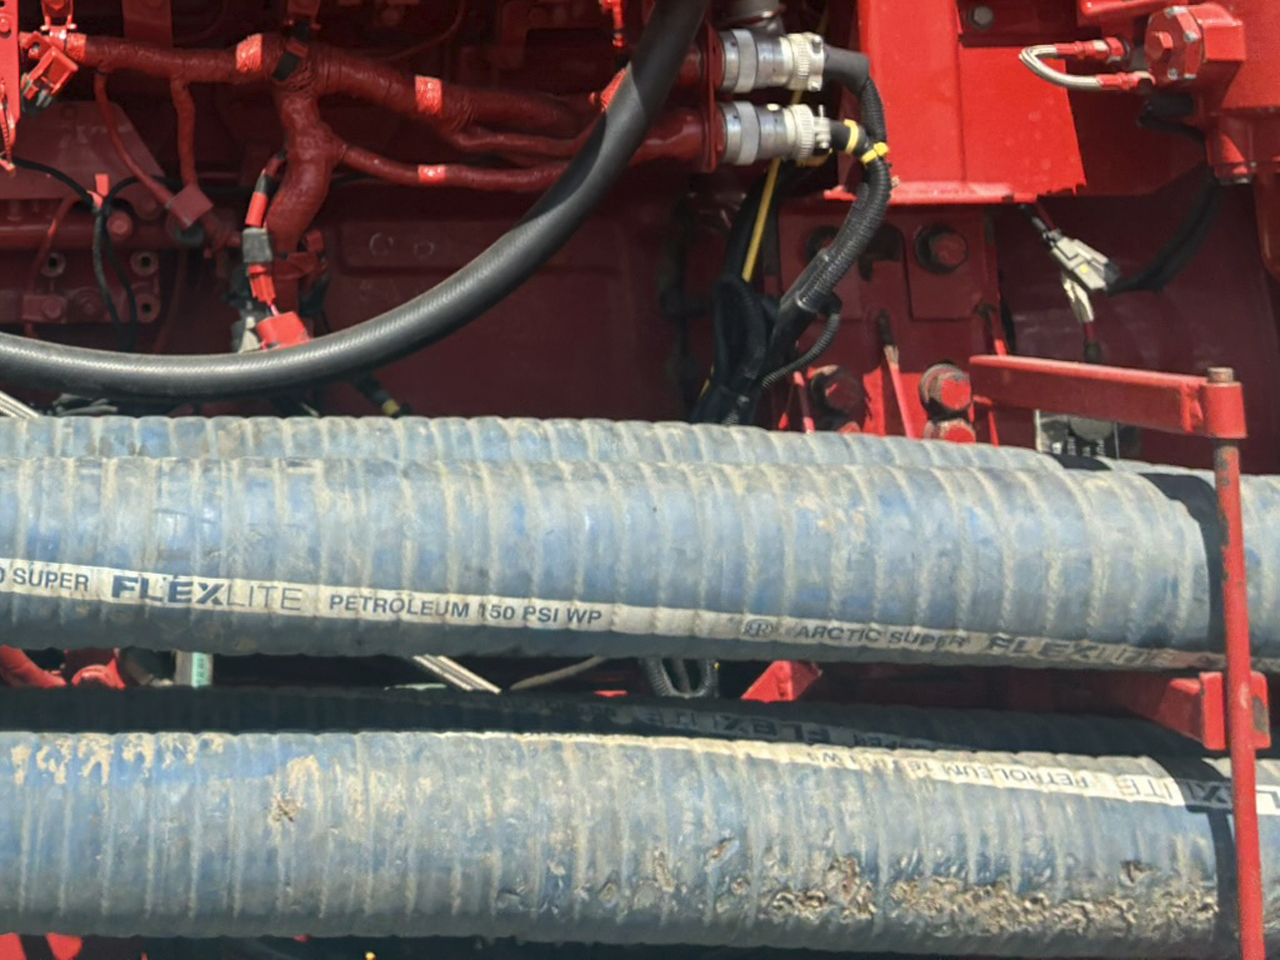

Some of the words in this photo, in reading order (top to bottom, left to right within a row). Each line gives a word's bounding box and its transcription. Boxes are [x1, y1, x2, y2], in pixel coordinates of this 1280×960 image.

[12, 567, 90, 592] SUPER
[111, 575, 304, 613] FLEXLITE
[329, 593, 470, 620] PETROLEUM
[478, 603, 515, 622] 150
[523, 605, 559, 624] PSI
[565, 607, 604, 626] WP
[794, 625, 882, 642] ARCTIC
